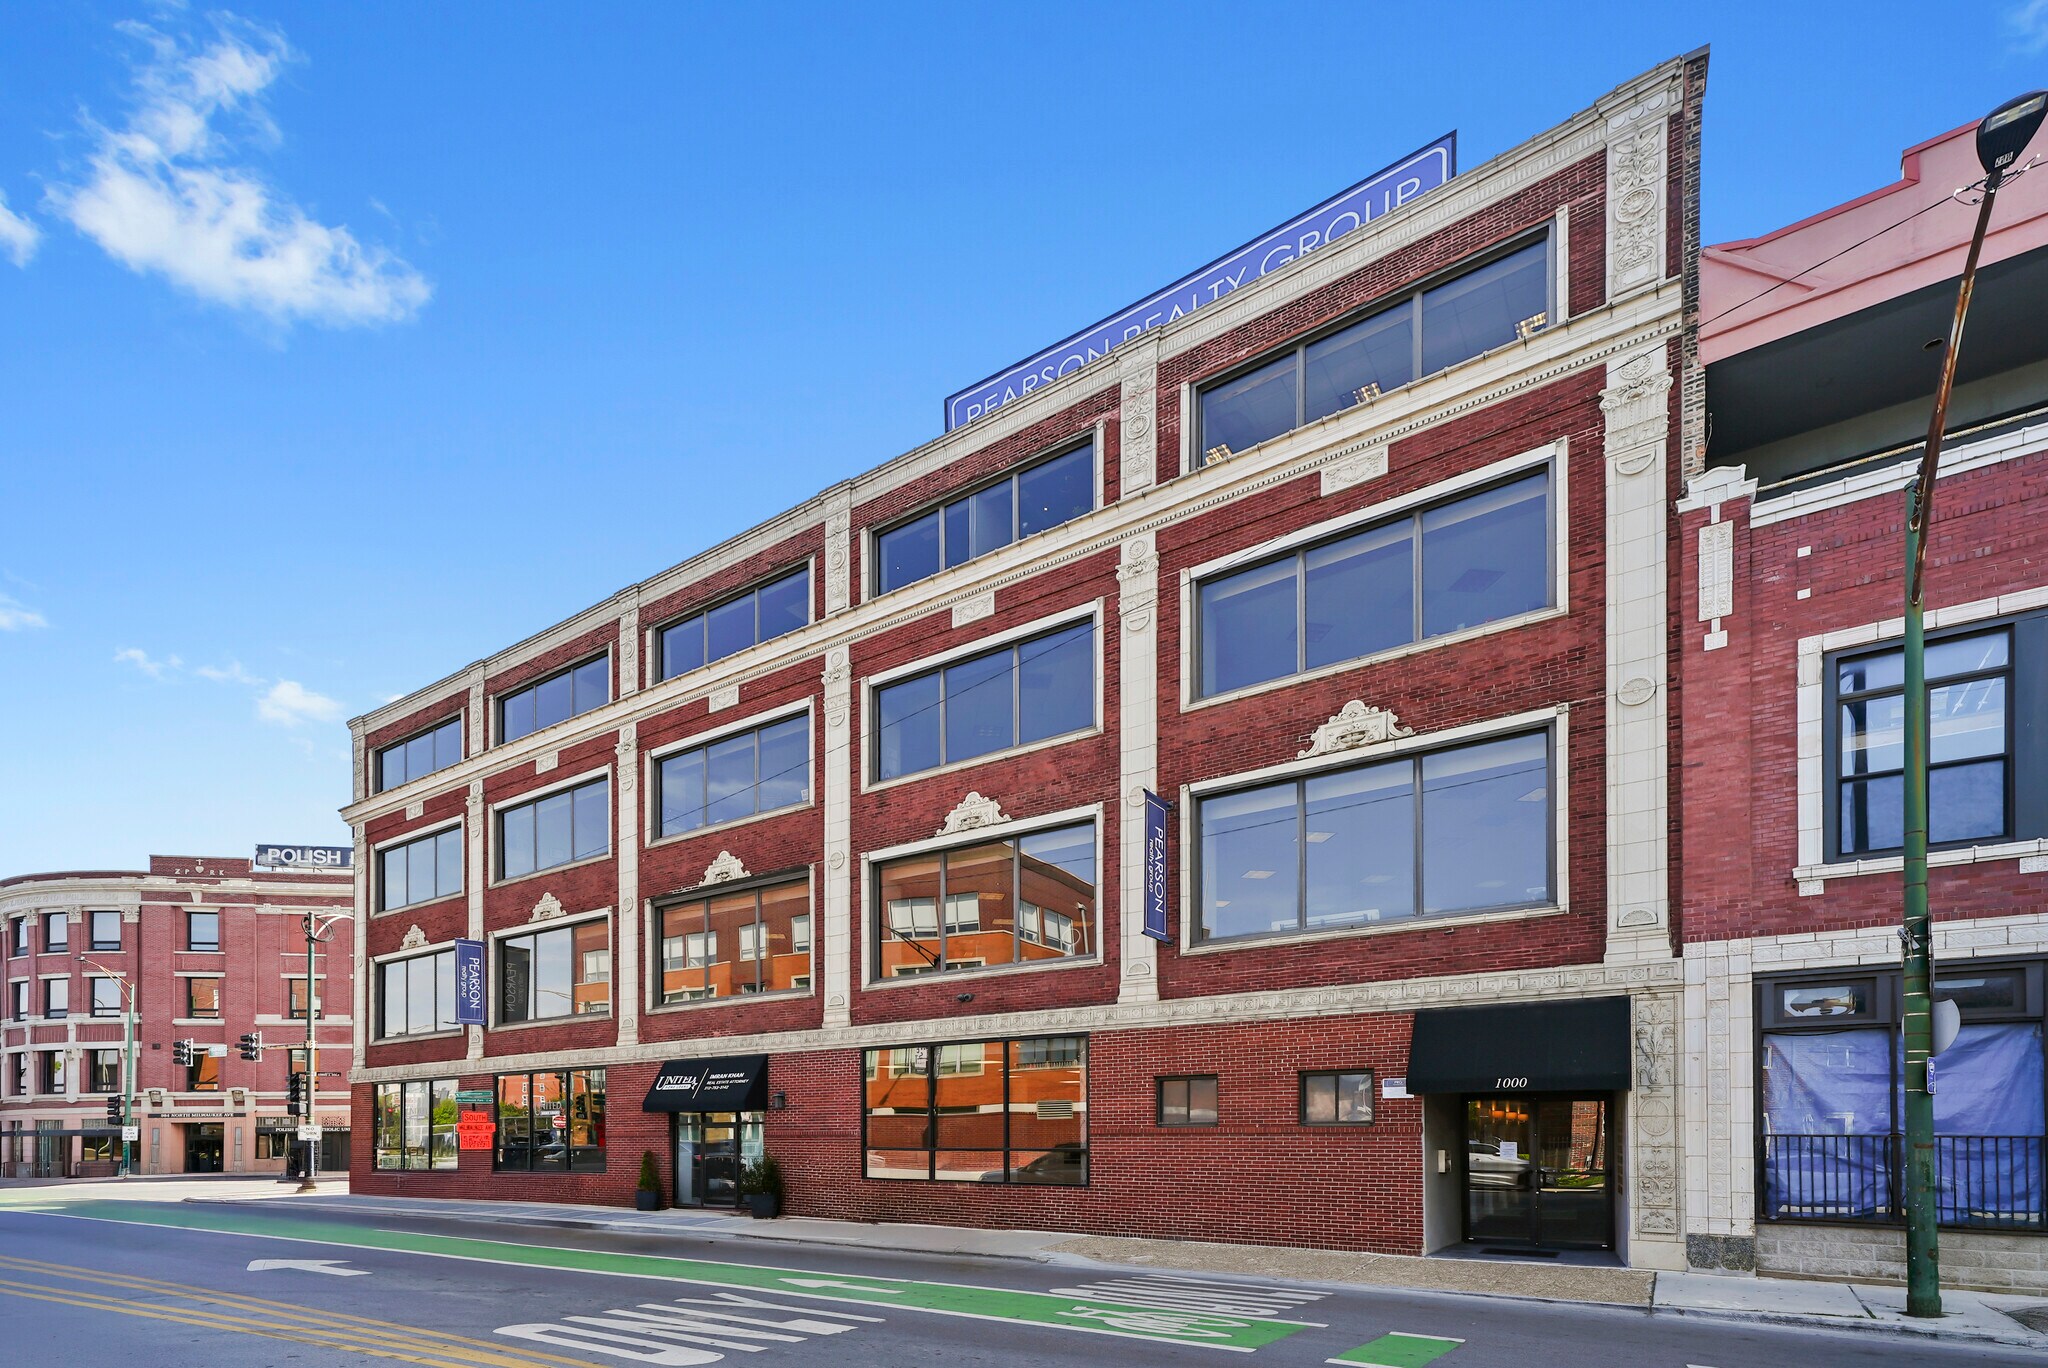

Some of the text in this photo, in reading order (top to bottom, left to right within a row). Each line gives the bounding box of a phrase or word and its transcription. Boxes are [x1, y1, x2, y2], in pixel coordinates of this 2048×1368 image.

[967, 338, 1109, 423] PEARSON
[1260, 177, 1421, 277] GROUP
[267, 848, 341, 864] POLISH
[1154, 825, 1164, 913] PEARSON
[469, 957, 481, 1009] PEARSON
[1495, 1077, 1528, 1089] 1000
[464, 1113, 486, 1121] SOUTH
[492, 1292, 886, 1367] ONLY
